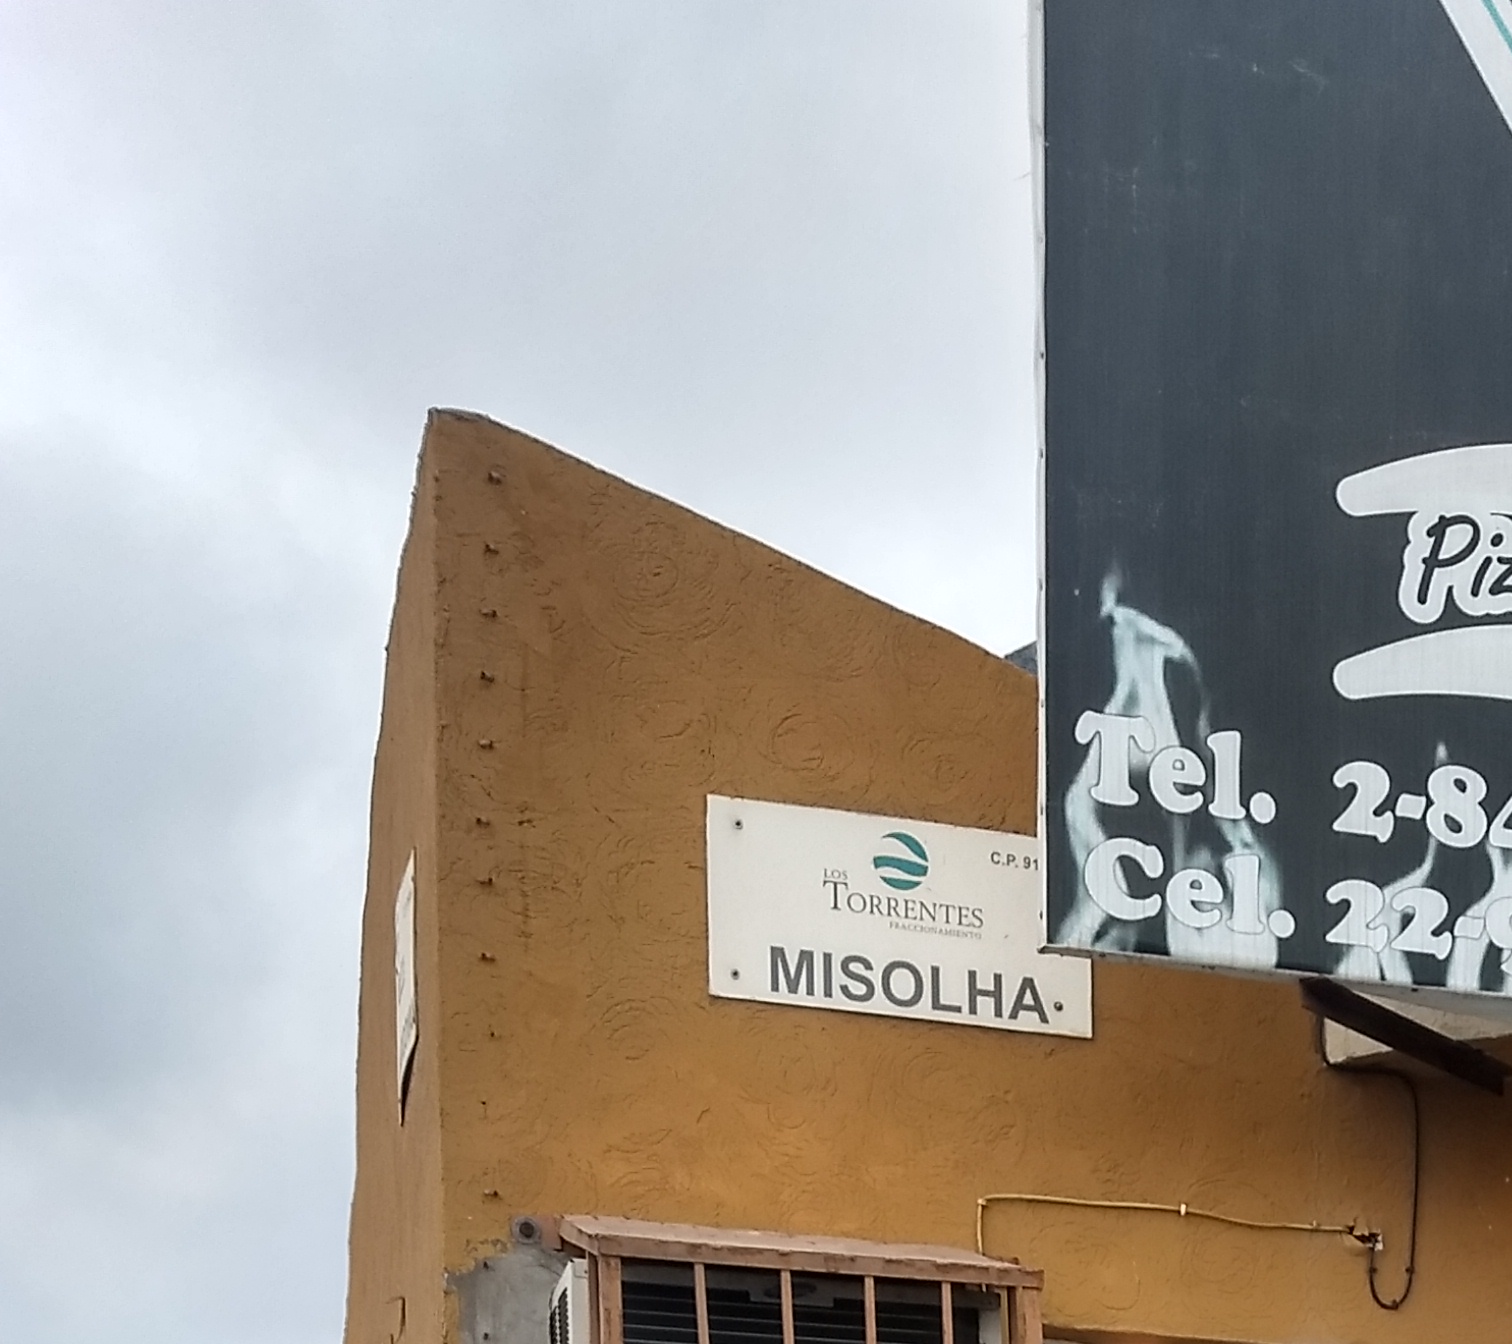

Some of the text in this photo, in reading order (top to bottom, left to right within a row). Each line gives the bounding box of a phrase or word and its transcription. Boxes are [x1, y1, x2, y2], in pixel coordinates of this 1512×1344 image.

[1075, 709, 1277, 825] Tel.
[823, 867, 848, 881] LOS
[990, 851, 1039, 871] C.P. 91
[822, 879, 984, 929] TORRENTES
[1084, 837, 1296, 939] Cel.
[889, 920, 982, 940] FRACCIONAMIENTO
[769, 945, 1050, 1024] MISOLHA
